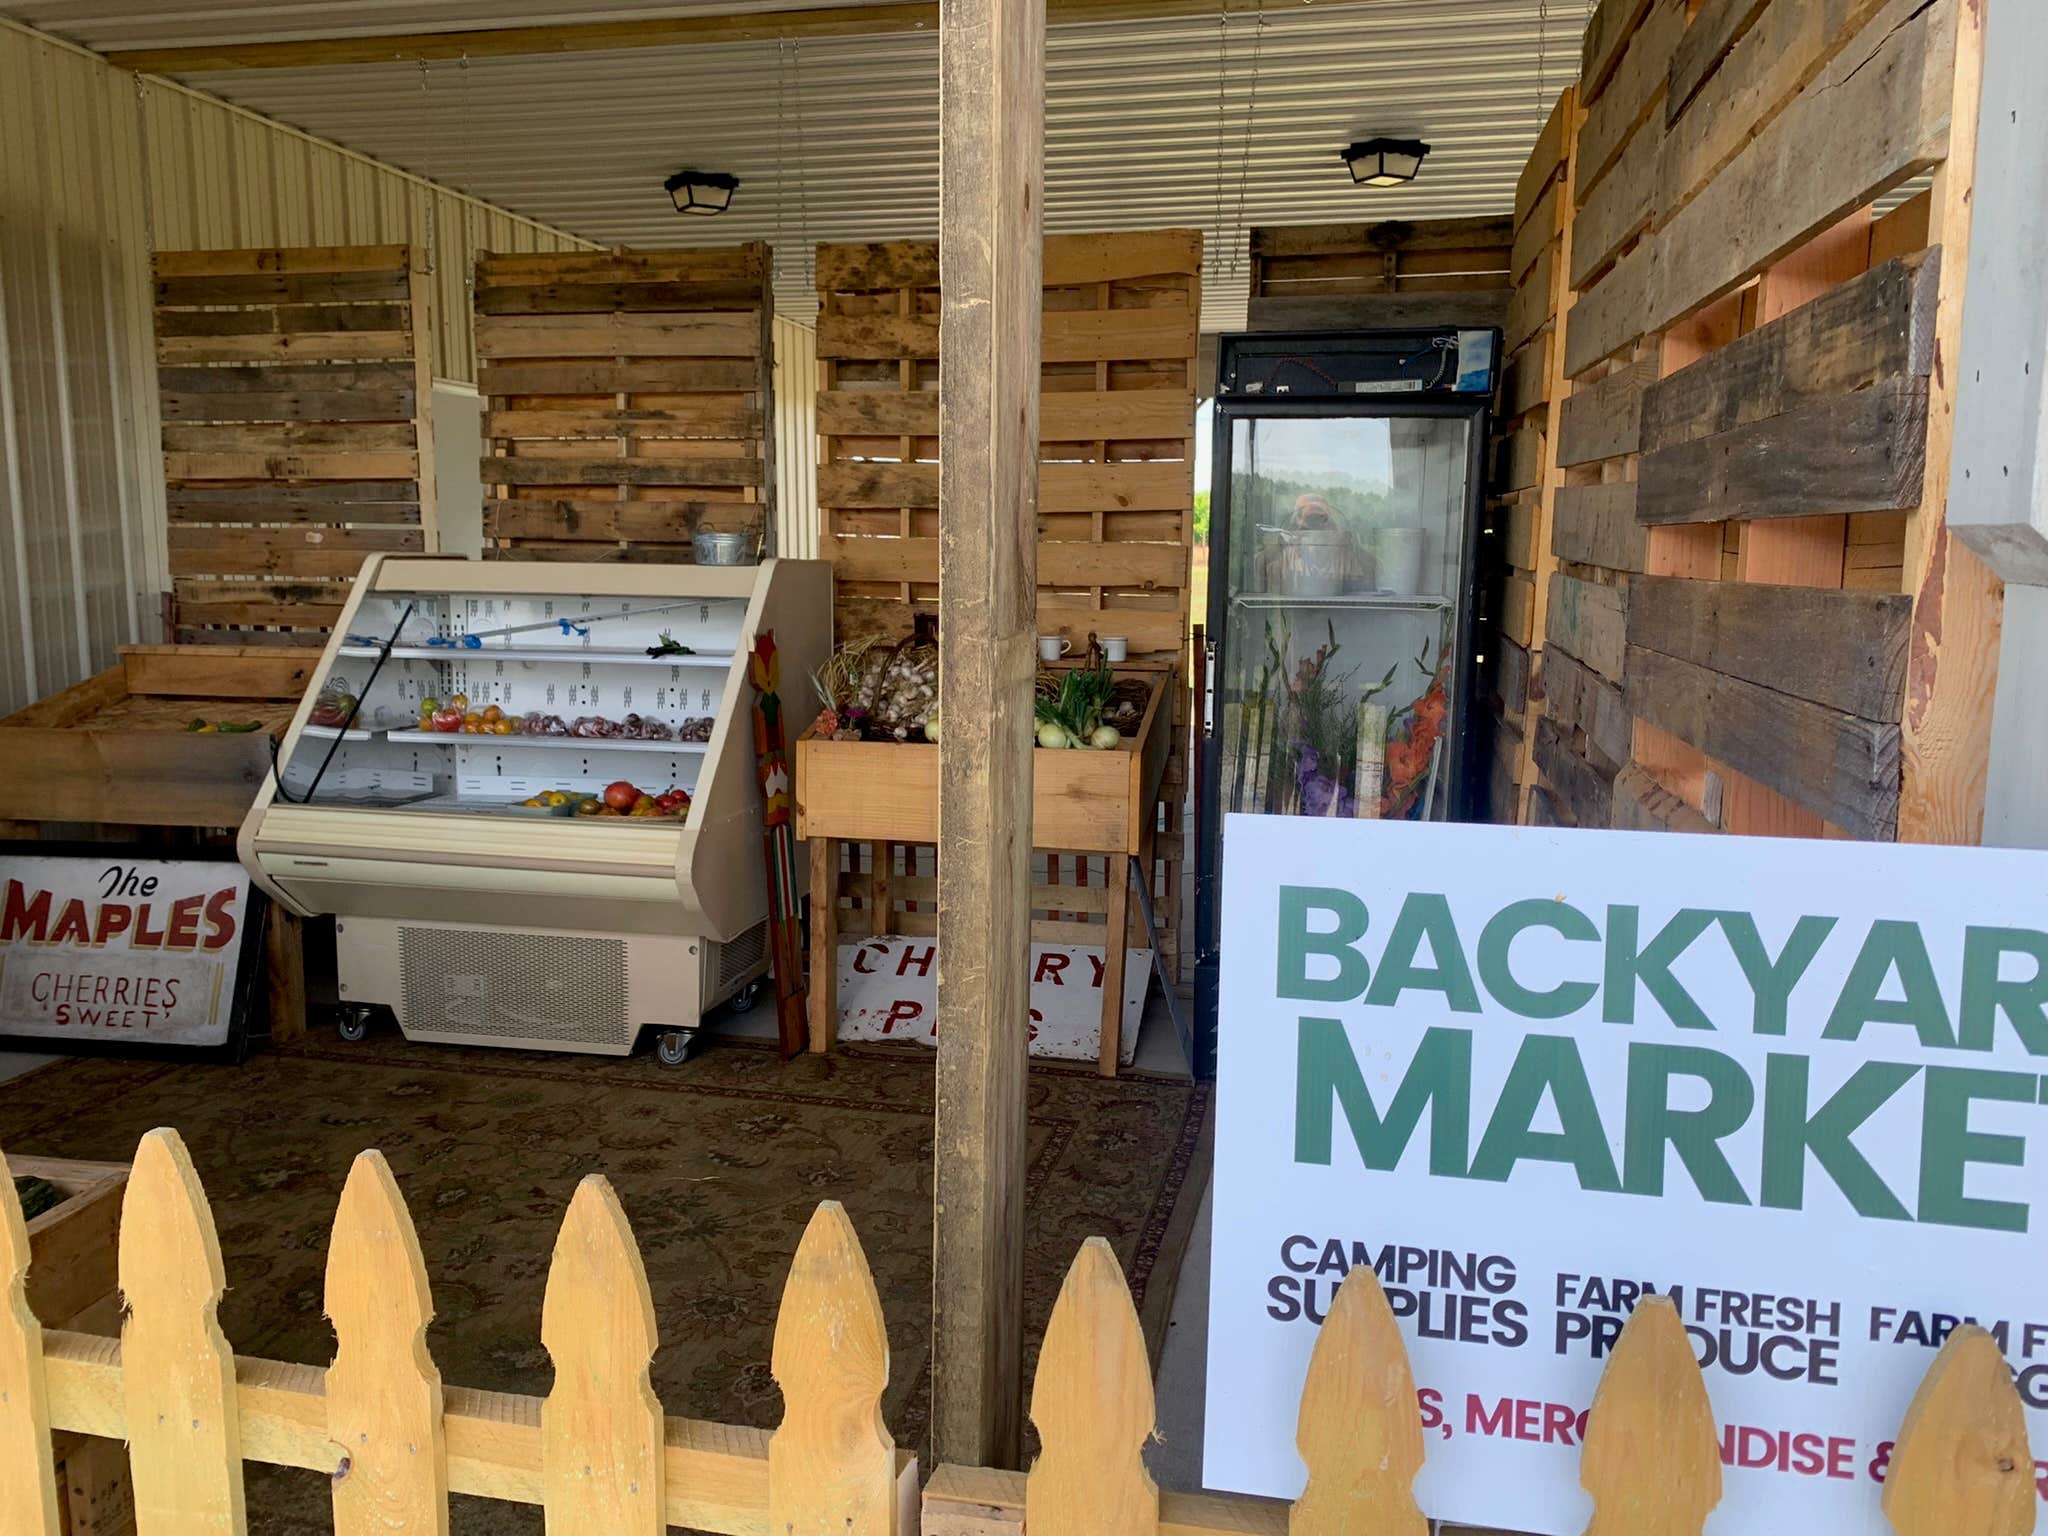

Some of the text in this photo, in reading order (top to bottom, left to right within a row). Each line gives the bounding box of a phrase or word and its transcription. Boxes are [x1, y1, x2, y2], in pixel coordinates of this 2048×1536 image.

[99, 865, 159, 899] The
[0, 878, 238, 953] MAPLES
[31, 972, 181, 1009] CHERRIES
[853, 943, 1106, 988] CHRY
[1294, 1016, 2048, 1234] MARKE
[1280, 1234, 1517, 1294] CAMPING
[1266, 1275, 1529, 1348] SUPLIES
[1695, 1287, 1841, 1337] FRESH
[1554, 1310, 1840, 1386] PRDUCE
